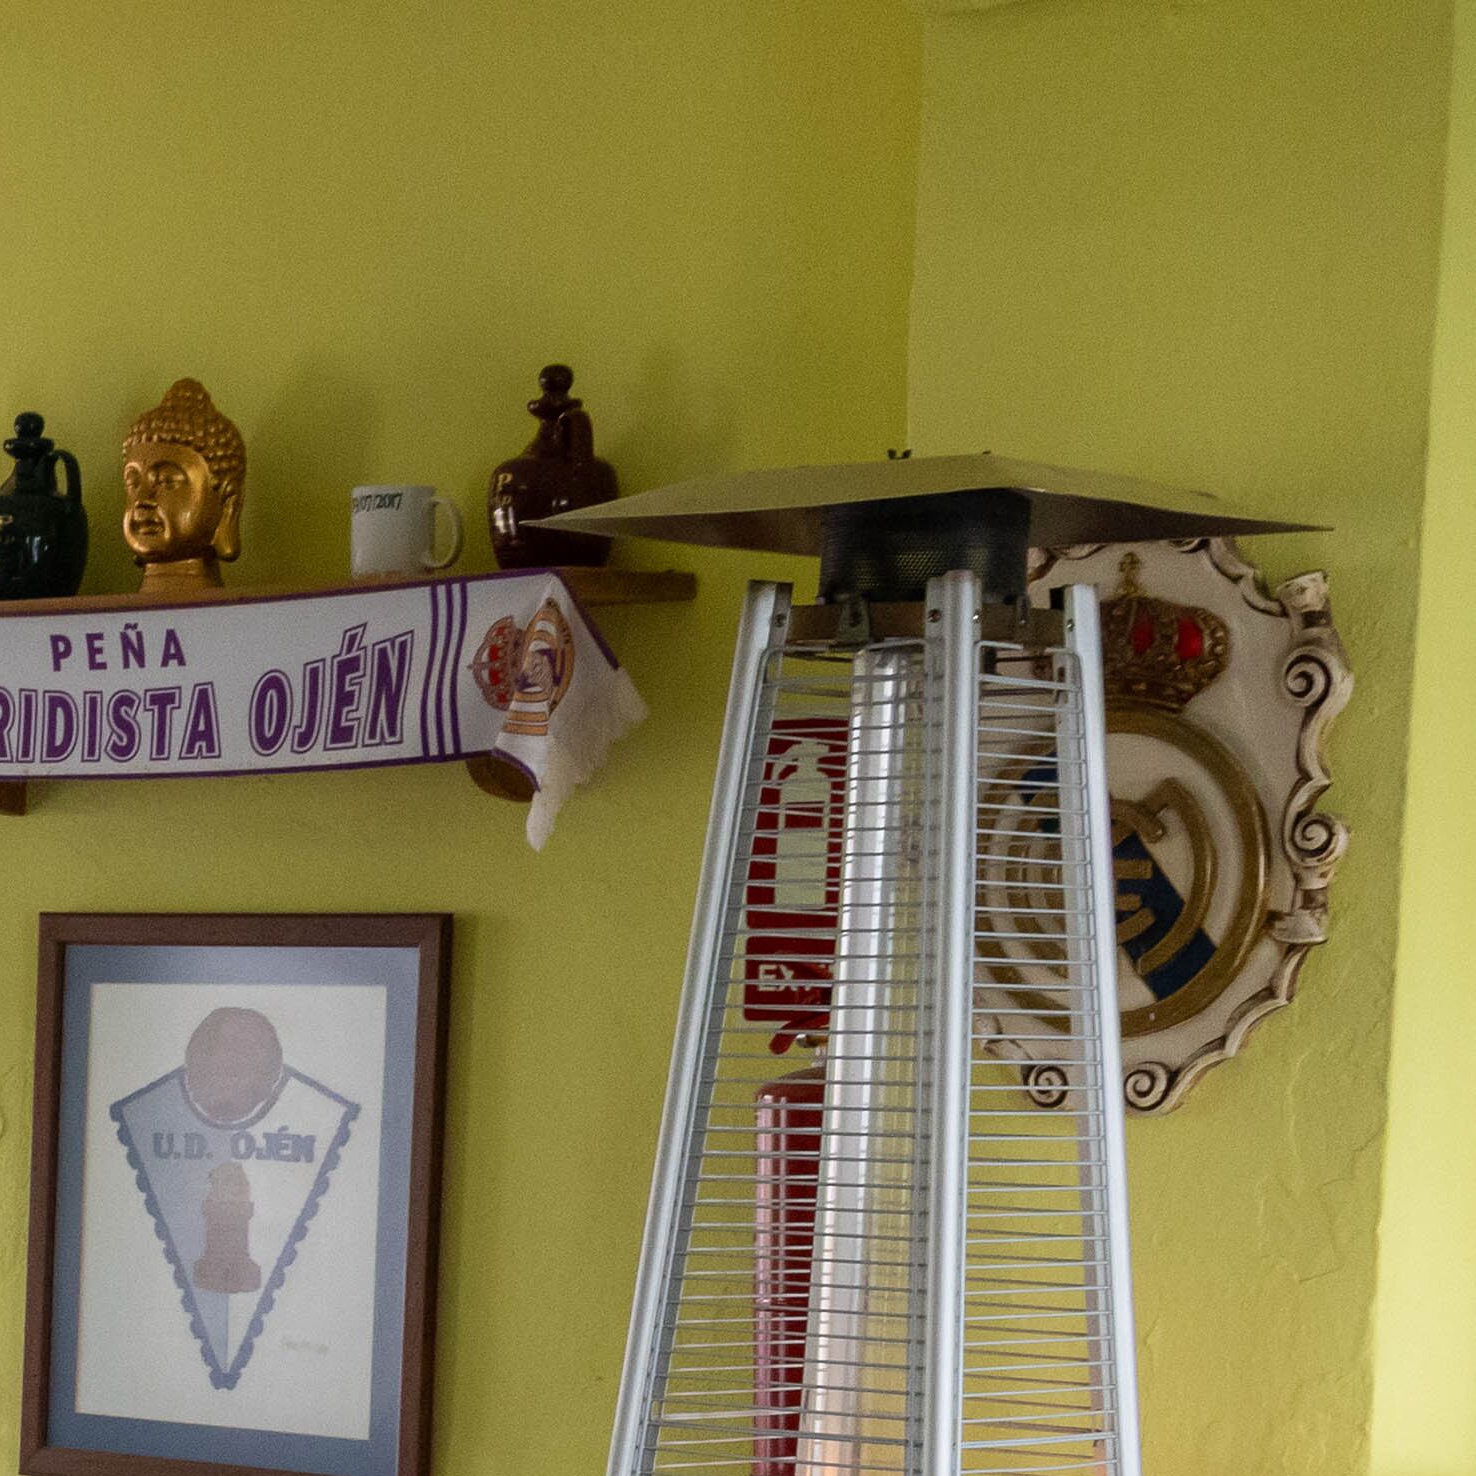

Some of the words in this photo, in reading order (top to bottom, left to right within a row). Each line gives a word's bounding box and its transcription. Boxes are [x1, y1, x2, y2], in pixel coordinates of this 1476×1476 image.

[49, 622, 188, 673] PEÑA
[249, 622, 415, 755] OJÉN
[229, 1125, 316, 1164] OJÉN
